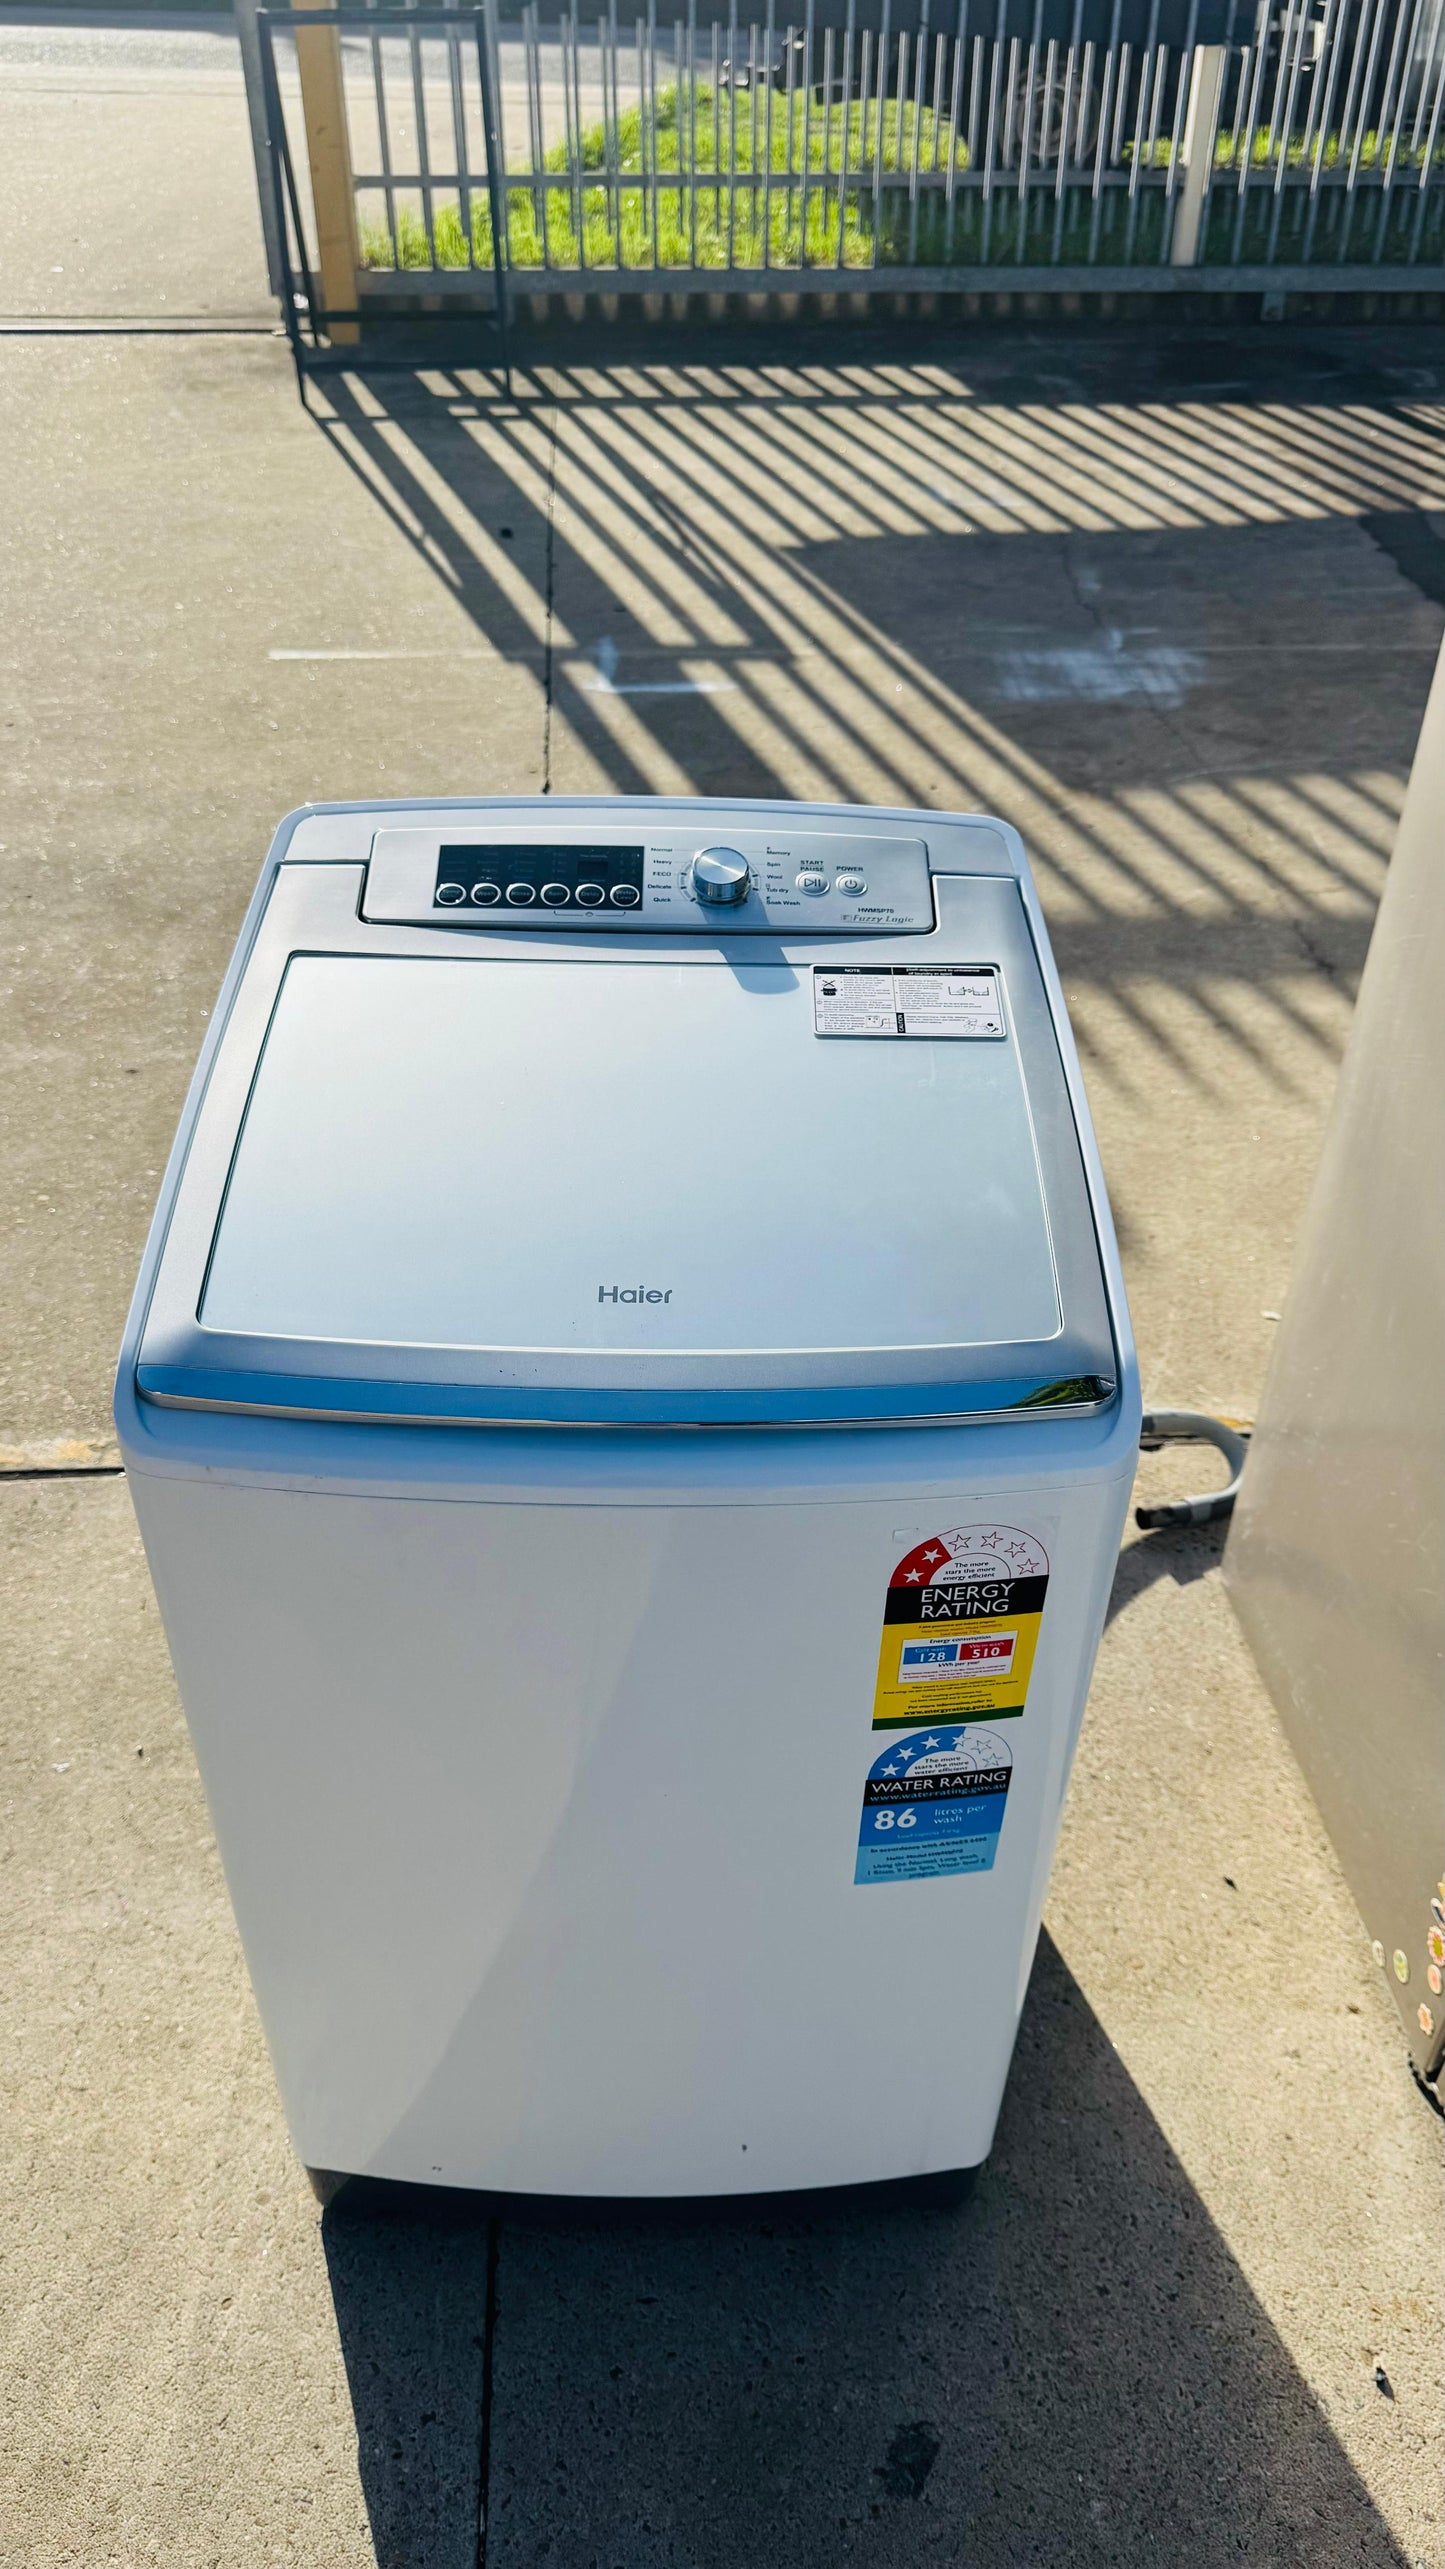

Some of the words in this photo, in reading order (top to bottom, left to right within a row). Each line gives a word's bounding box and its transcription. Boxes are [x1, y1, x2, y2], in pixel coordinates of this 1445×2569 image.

[853, 914, 883, 923] Fuzzy
[885, 916, 914, 924] Logic
[598, 1285, 673, 1304] Haier
[921, 1582, 1016, 1603] ENERGY
[921, 1598, 1010, 1619] RATING
[920, 1652, 946, 1662] 128
[971, 1647, 1000, 1658] 510
[872, 1780, 934, 1793] WATER
[939, 1771, 1007, 1788] RATING
[869, 1783, 1006, 1802] www.waterrating.gov.au
[874, 1808, 917, 1830] 86
[934, 1807, 963, 1816] litres
[966, 1805, 987, 1815] per
[933, 1815, 962, 1824] wash
